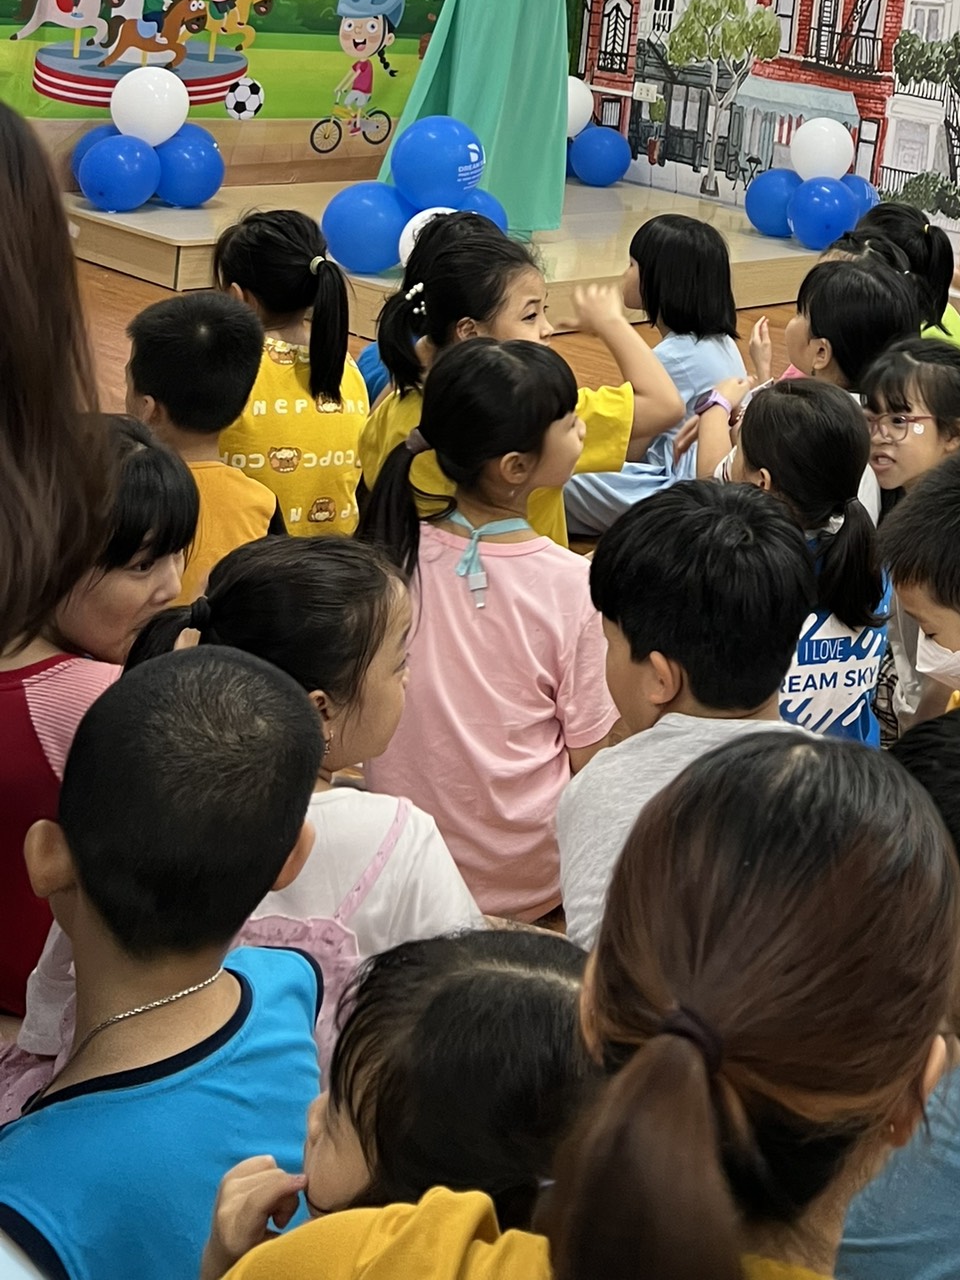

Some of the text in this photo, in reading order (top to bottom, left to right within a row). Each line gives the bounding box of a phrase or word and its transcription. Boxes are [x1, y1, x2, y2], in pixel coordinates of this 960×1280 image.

[804, 638, 845, 661] I LOVE
[780, 665, 878, 694] EAM SKY
